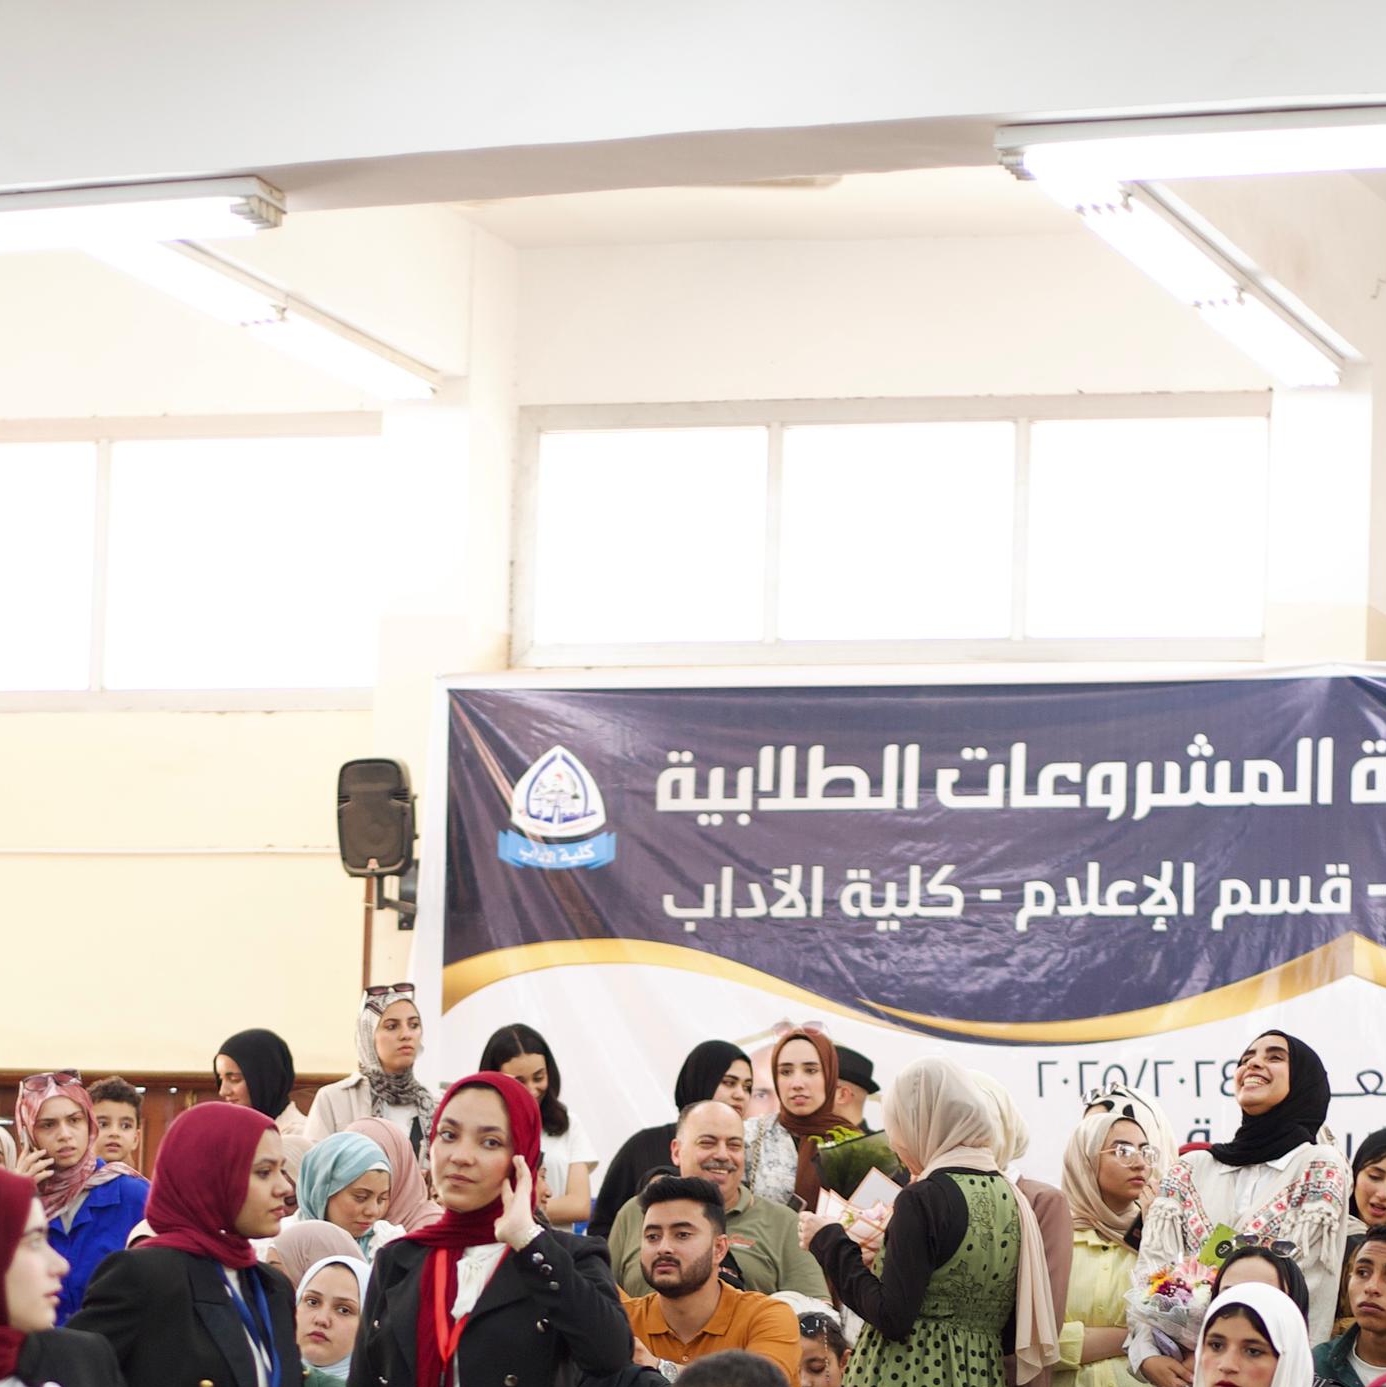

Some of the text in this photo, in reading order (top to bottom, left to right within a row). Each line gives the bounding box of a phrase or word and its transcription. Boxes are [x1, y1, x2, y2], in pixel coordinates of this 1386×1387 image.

[656, 743, 920, 826] الطلابية
[936, 733, 1334, 821] المشروعات
[663, 865, 824, 932] الآداب
[840, 865, 964, 931] كلية
[1015, 861, 1195, 932] الإعلام
[1211, 863, 1352, 930] قسم
